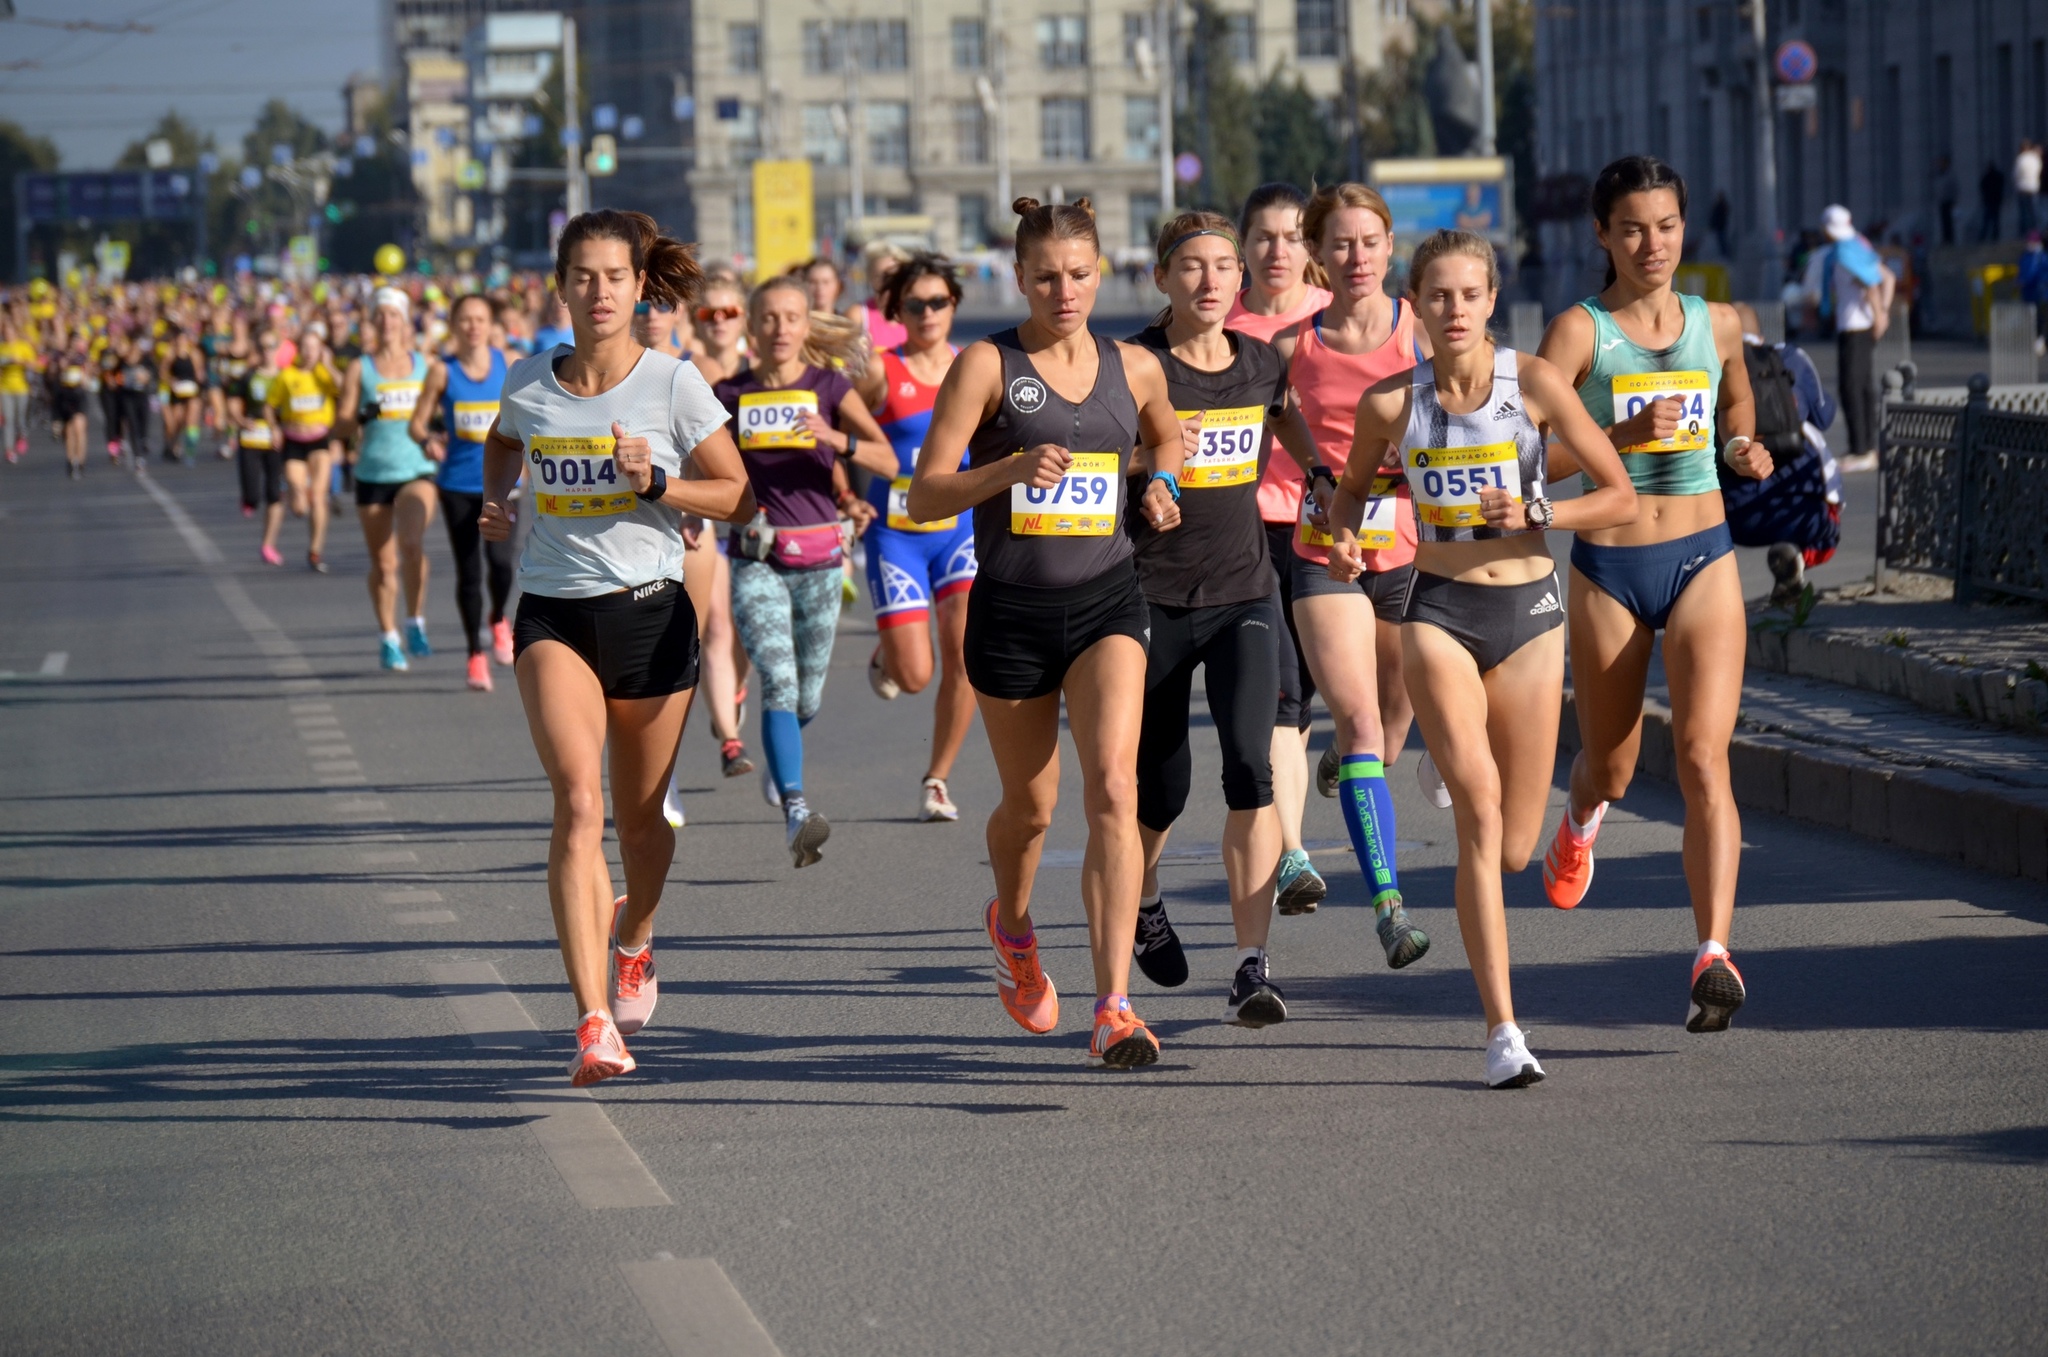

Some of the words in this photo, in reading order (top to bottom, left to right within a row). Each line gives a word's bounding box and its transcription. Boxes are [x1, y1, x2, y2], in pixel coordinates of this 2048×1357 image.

[1197, 428, 1254, 457] 350
[1417, 454, 1428, 465] A
[1423, 452, 1495, 462] ОЛУМАРАФОН
[540, 458, 617, 486] 0014
[1423, 465, 1507, 498] 0551
[545, 495, 558, 513] NL
[1021, 513, 1043, 533] NL
[1428, 506, 1444, 523] NL
[633, 580, 665, 601] NIKE
[1530, 602, 1559, 616] adidas
[1353, 787, 1383, 869] COMPRESSPORT
